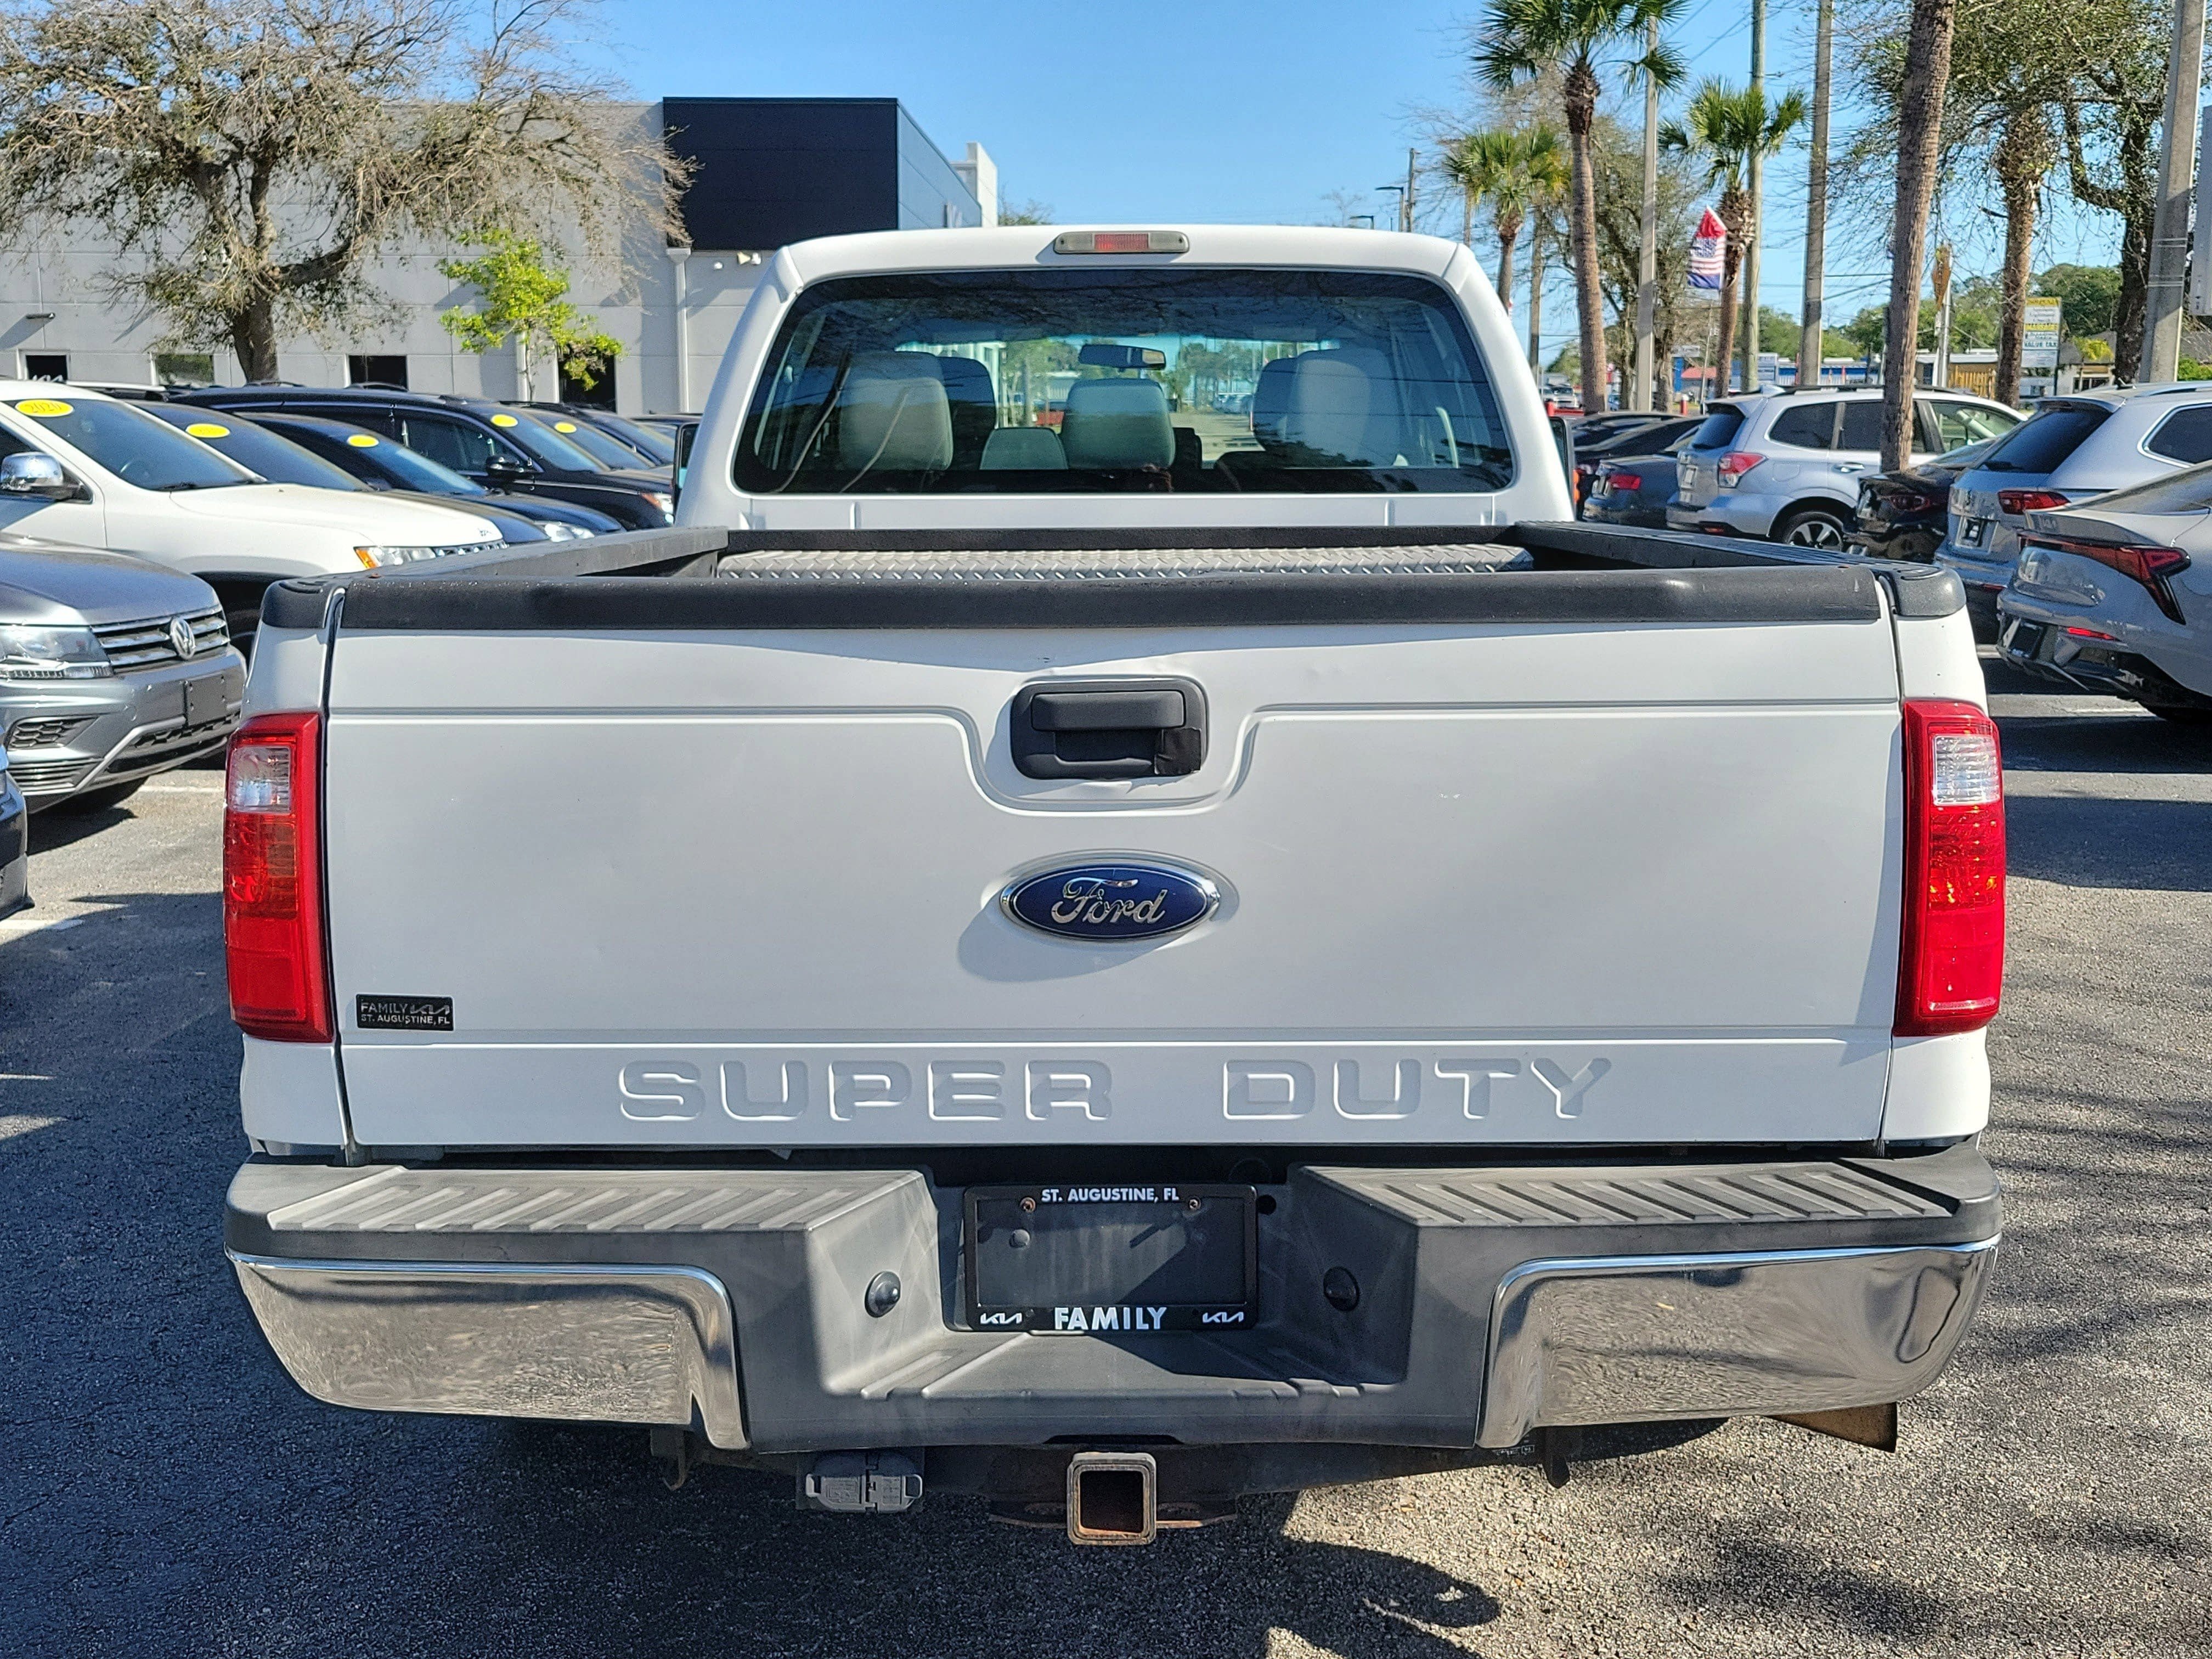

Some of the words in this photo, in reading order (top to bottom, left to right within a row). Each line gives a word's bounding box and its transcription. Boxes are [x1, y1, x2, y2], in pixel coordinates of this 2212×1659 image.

[1051, 876, 1167, 924] Ford
[360, 1002, 408, 1013] FAMILY
[360, 1014, 375, 1022] ST.
[377, 1014, 437, 1025] AUGUSTINE,
[438, 1016, 450, 1024] FL
[618, 1059, 1113, 1122] SUPER
[1222, 1057, 1612, 1120] DUTY
[1041, 1188, 1063, 1202] ST.
[1068, 1188, 1159, 1203] AUGUSTINE,
[1164, 1187, 1180, 1200] FL
[979, 1312, 1023, 1324] KIA
[1054, 1307, 1167, 1330] FAMILY
[1202, 1311, 1244, 1323] KIA
